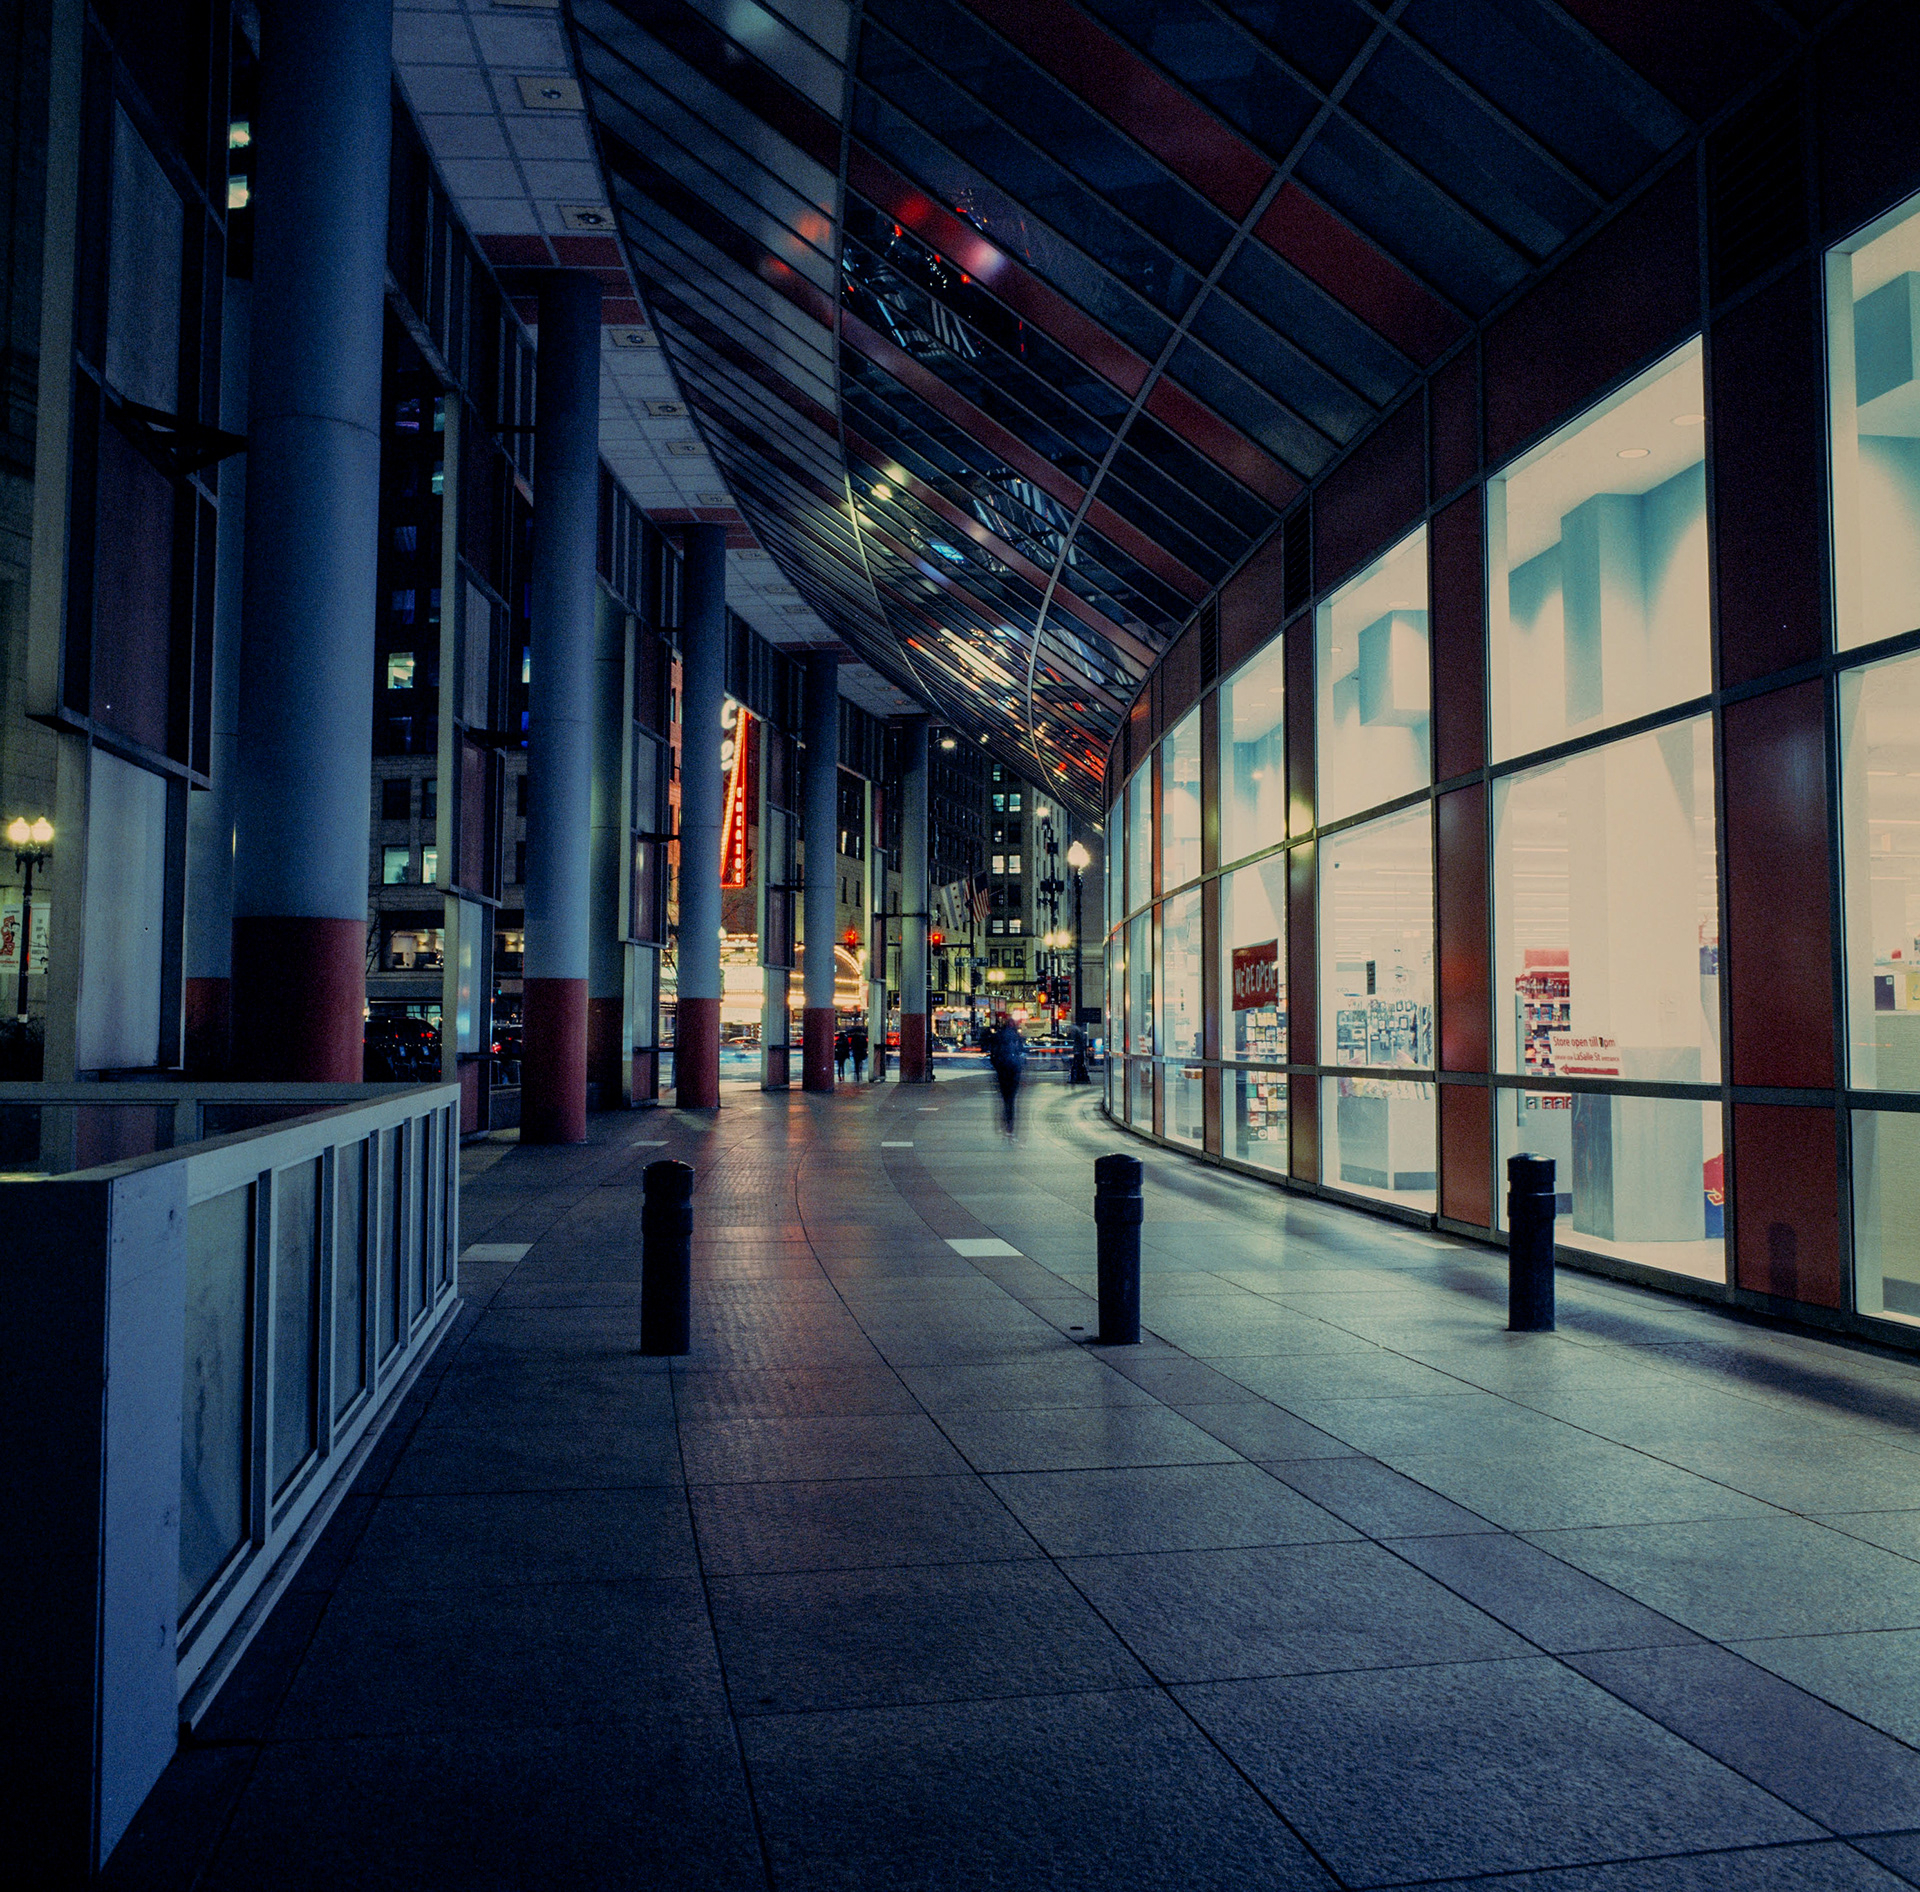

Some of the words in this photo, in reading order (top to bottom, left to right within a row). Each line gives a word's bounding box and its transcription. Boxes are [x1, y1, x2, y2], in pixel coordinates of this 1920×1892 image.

[1234, 962, 1255, 998] WE'RE
[1553, 1036, 1570, 1047] Store
[1571, 1038, 1588, 1049] open
[1588, 1036, 1599, 1047] till
[1573, 1052, 1594, 1061] LaSalle
[1594, 1052, 1601, 1061] St
